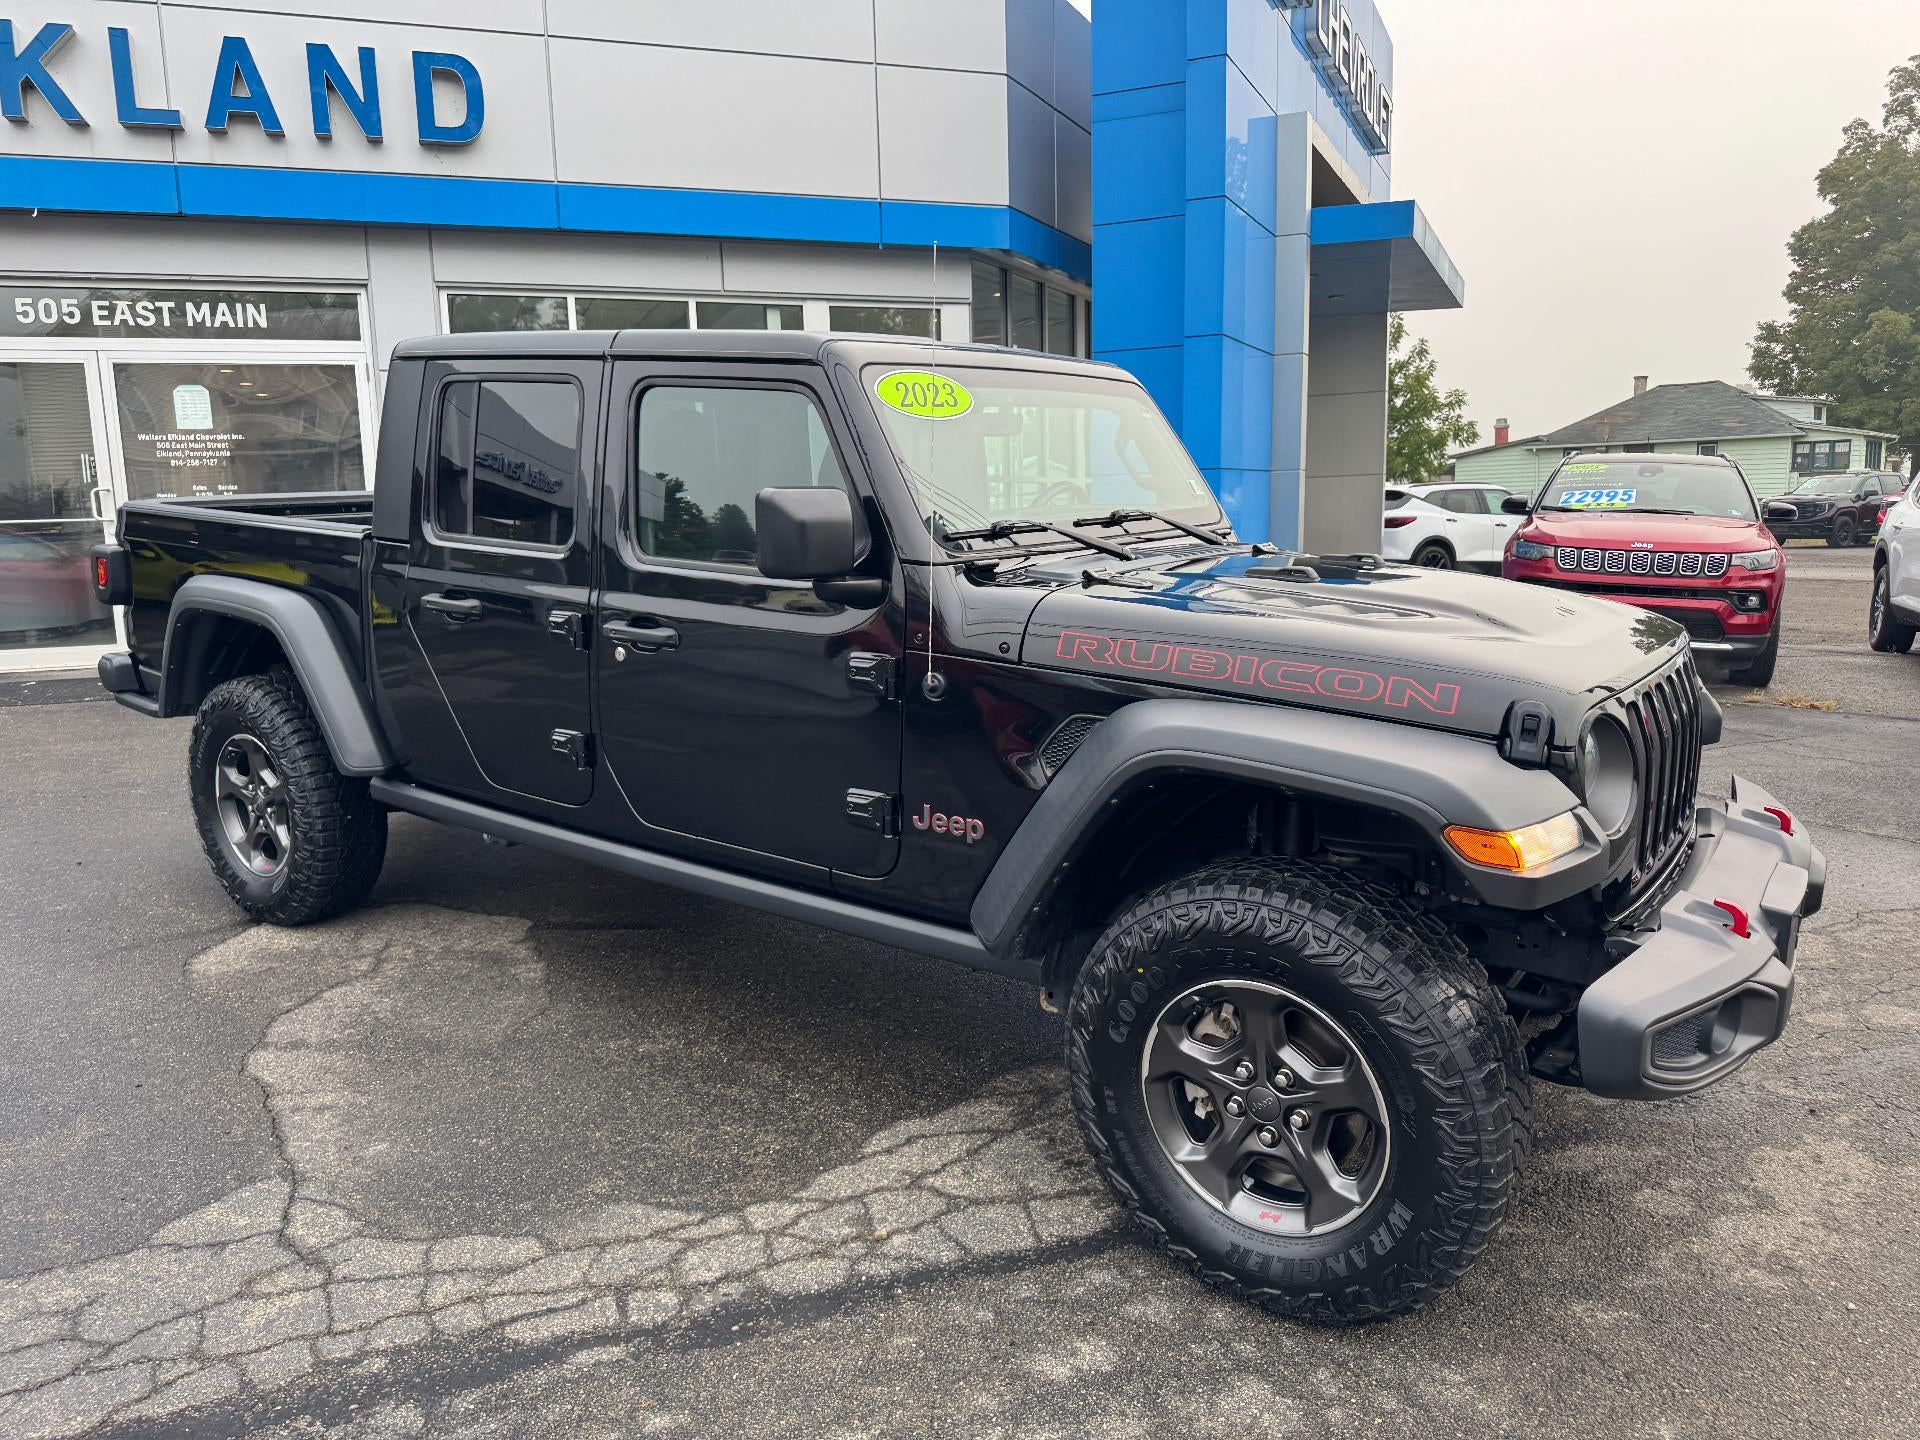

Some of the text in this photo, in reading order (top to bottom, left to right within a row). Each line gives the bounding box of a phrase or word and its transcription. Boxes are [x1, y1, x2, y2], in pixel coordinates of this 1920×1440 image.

[0, 19, 486, 146] KLAND
[1318, 0, 1393, 153] CHEVROLET
[14, 297, 269, 328] 505 EAST MAIN
[895, 381, 959, 408] 2023
[137, 433, 167, 441] Walters
[195, 433, 231, 441] Chevrolet
[206, 441, 229, 449] Street
[184, 450, 231, 459] Pennsylvania
[1560, 489, 1634, 505] 22995
[1630, 541, 1654, 549] Jeep
[1056, 630, 1461, 715] RUBICON
[912, 804, 985, 844] Jeep
[1223, 1198, 1415, 1284] WRANGLER
